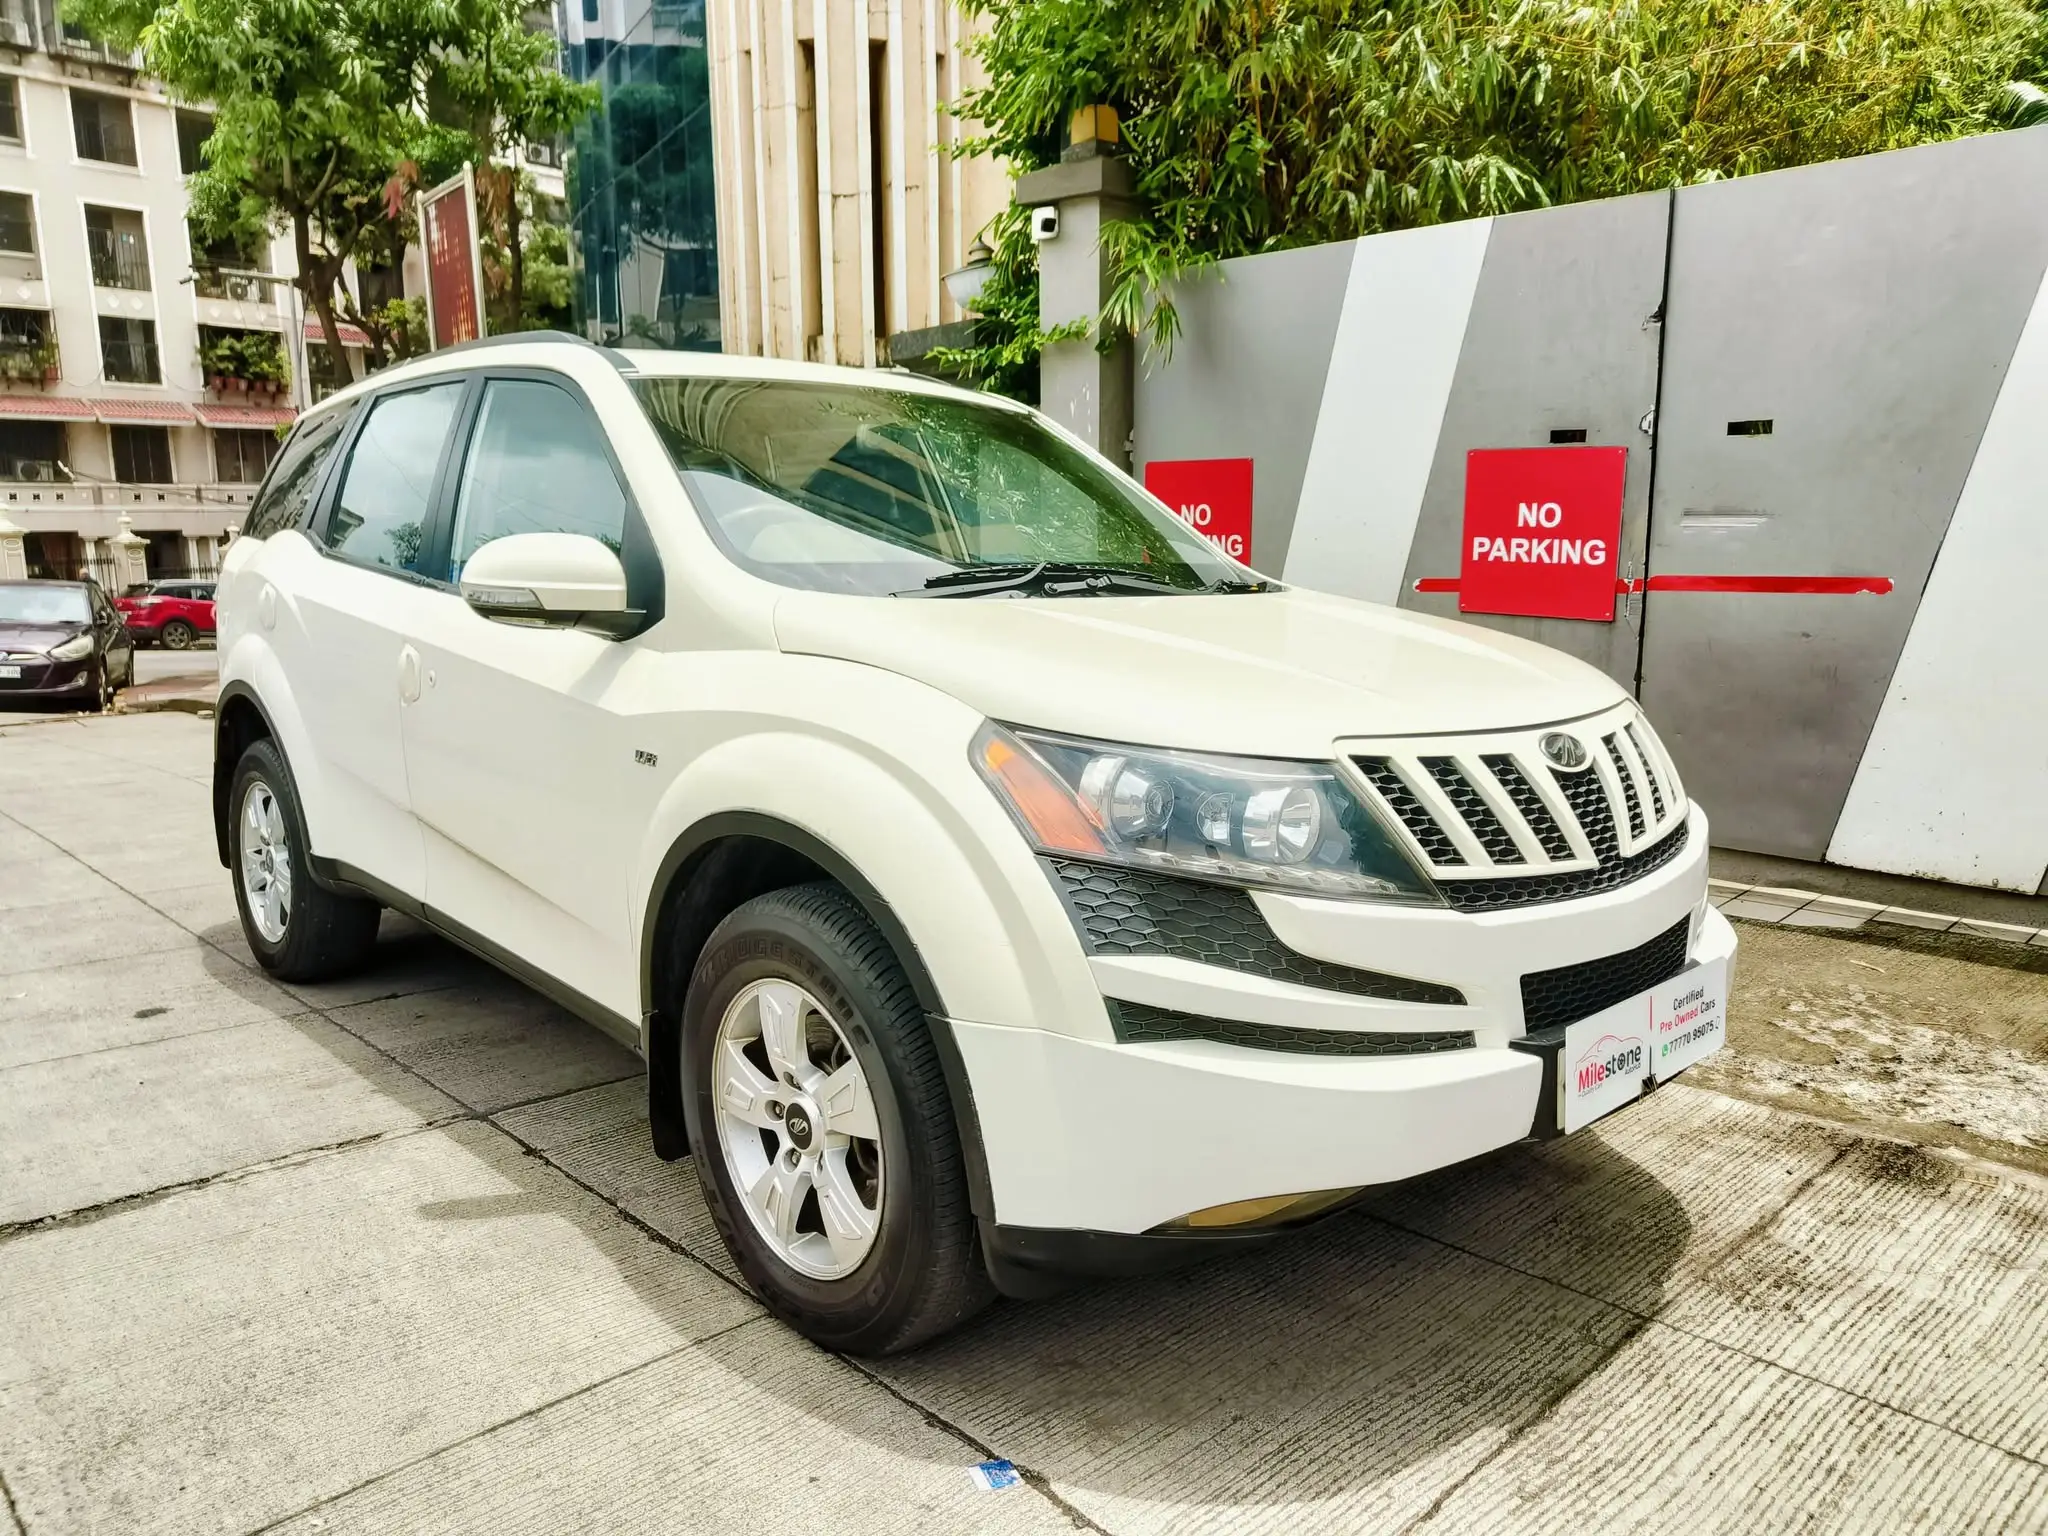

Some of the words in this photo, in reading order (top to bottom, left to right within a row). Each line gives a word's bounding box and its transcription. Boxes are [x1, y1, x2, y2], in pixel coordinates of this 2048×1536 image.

[1180, 503, 1212, 526] NO
[1517, 502, 1562, 528] NO
[1472, 536, 1606, 565] PARKING
[1673, 986, 1704, 1011] Certified
[1660, 1021, 1673, 1035] Pre
[1674, 1004, 1699, 1027] Owned
[1700, 998, 1716, 1014] Cars
[1578, 1045, 1642, 1093] Milestone
